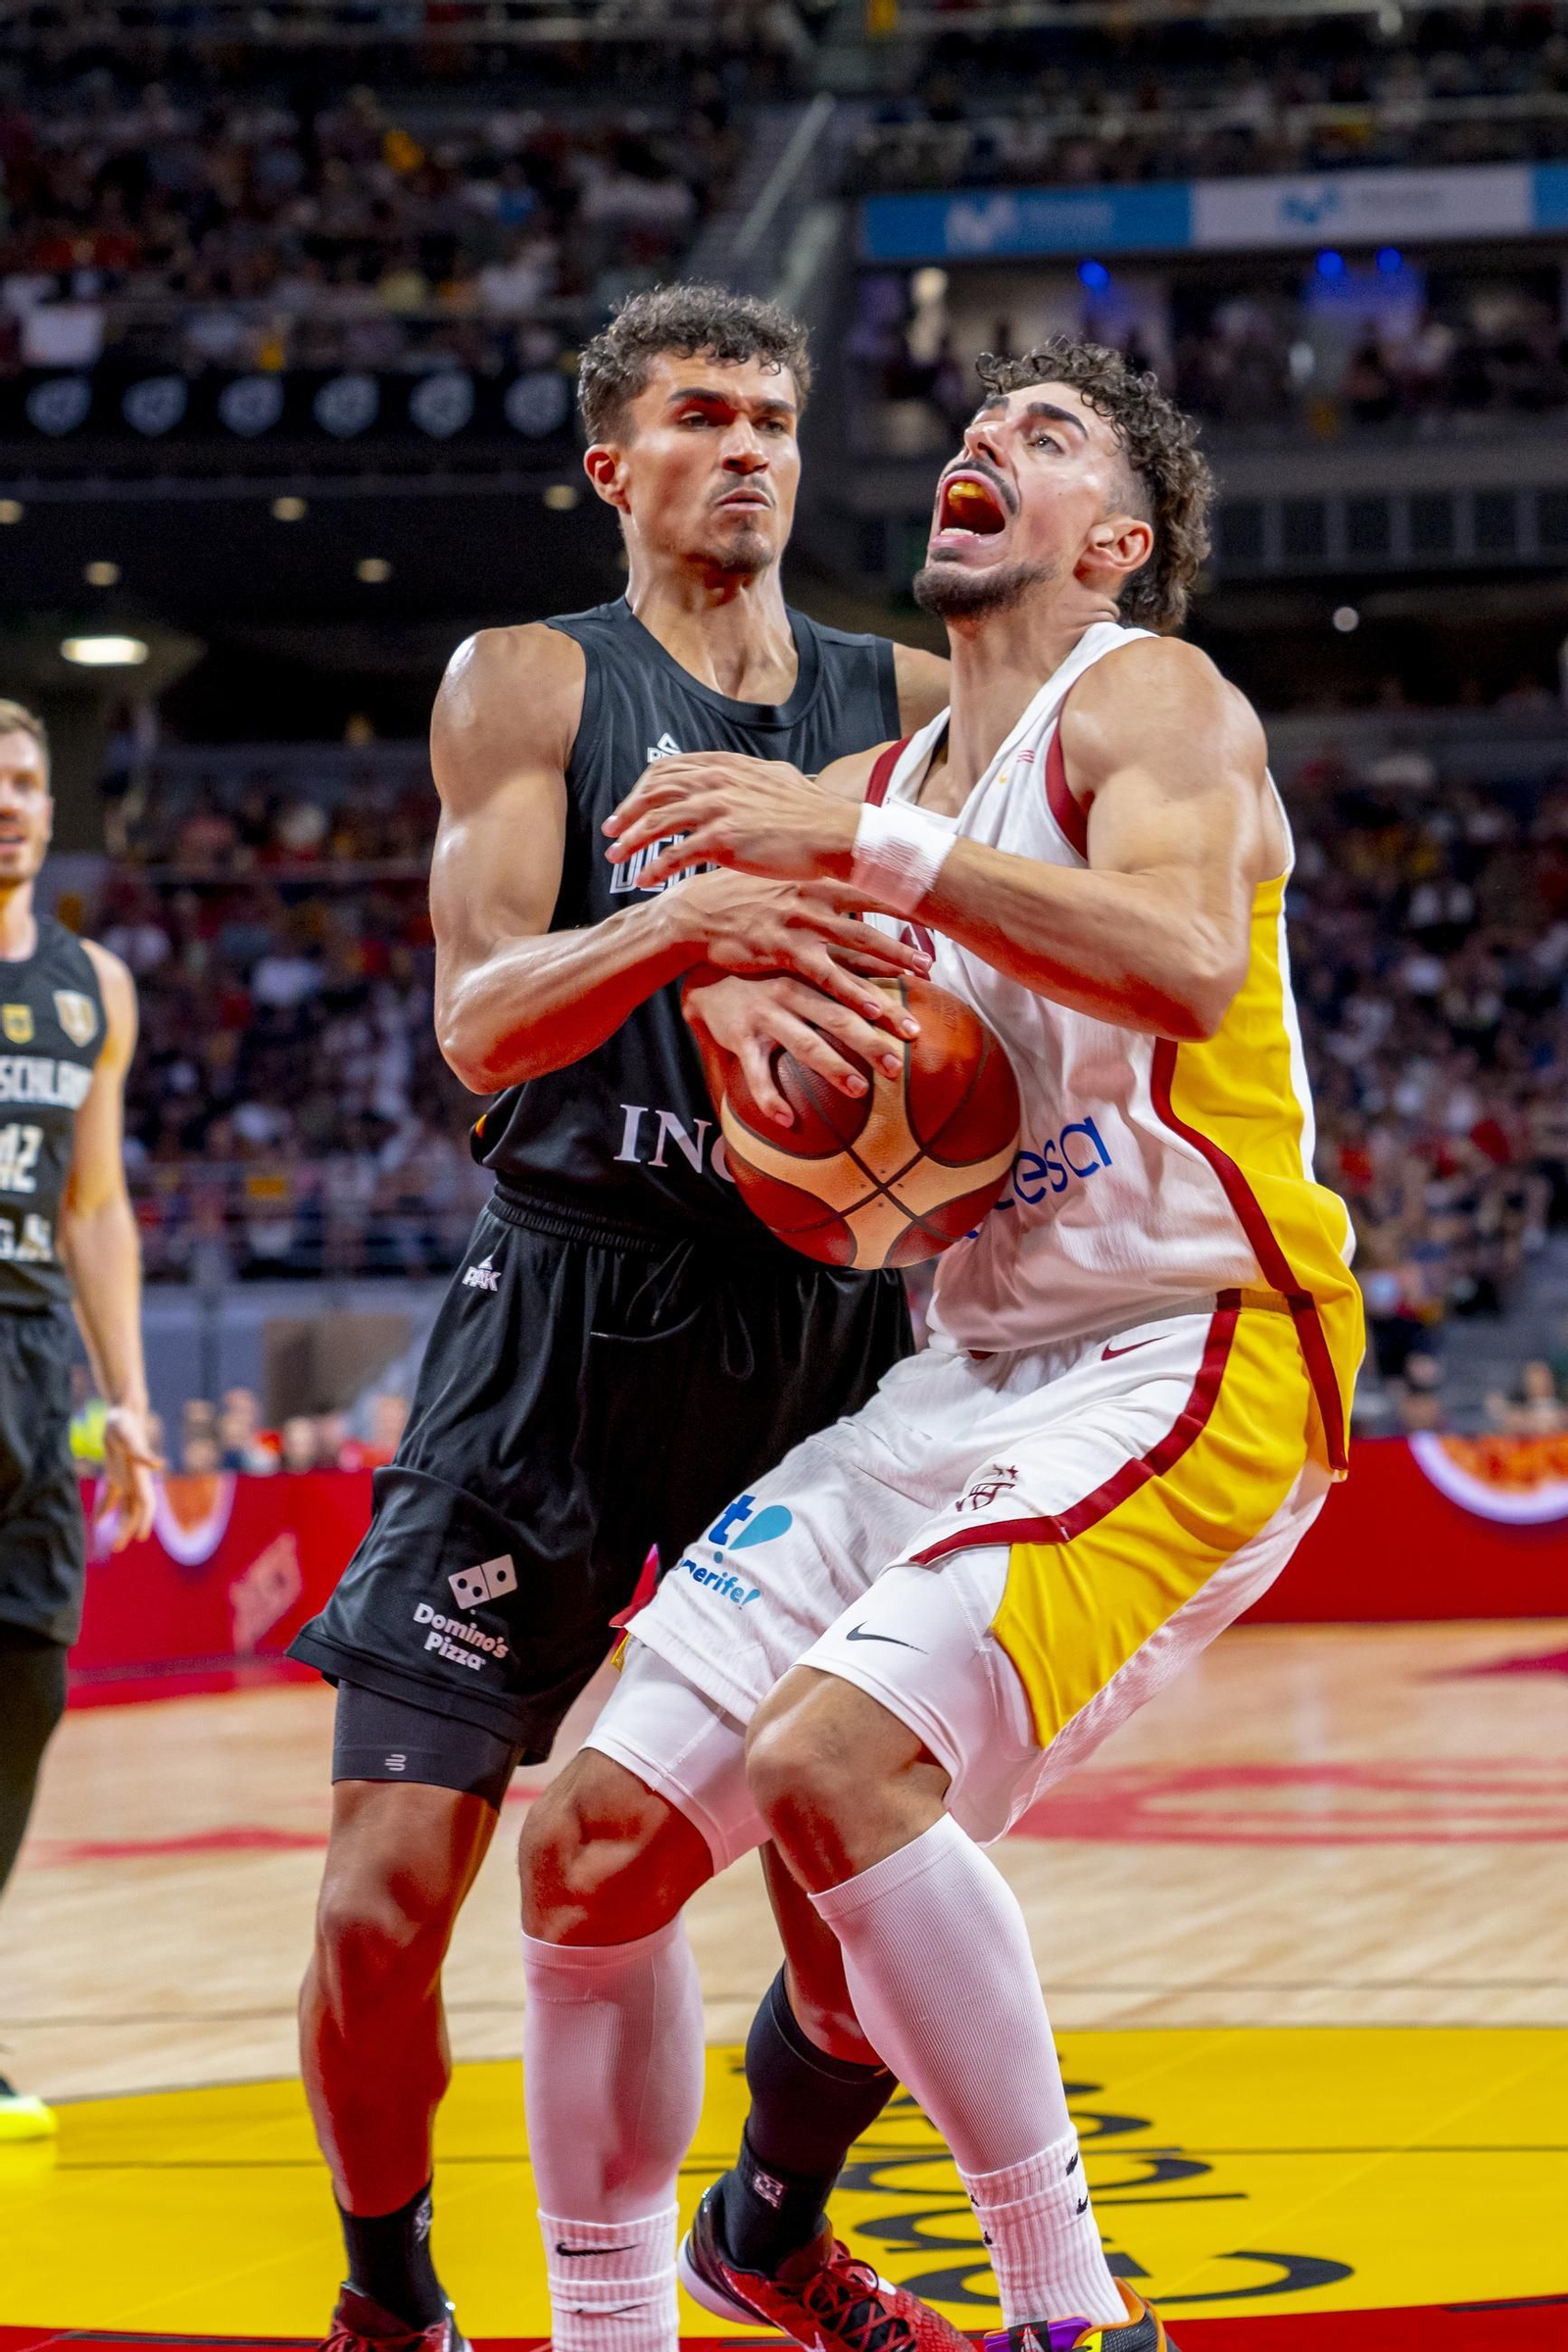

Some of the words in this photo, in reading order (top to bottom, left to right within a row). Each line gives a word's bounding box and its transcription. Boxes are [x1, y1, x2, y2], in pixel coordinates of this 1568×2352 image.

[613, 1104, 735, 1183] IN
[413, 1602, 510, 1659] Domino's
[423, 1631, 486, 1671] Pizza
